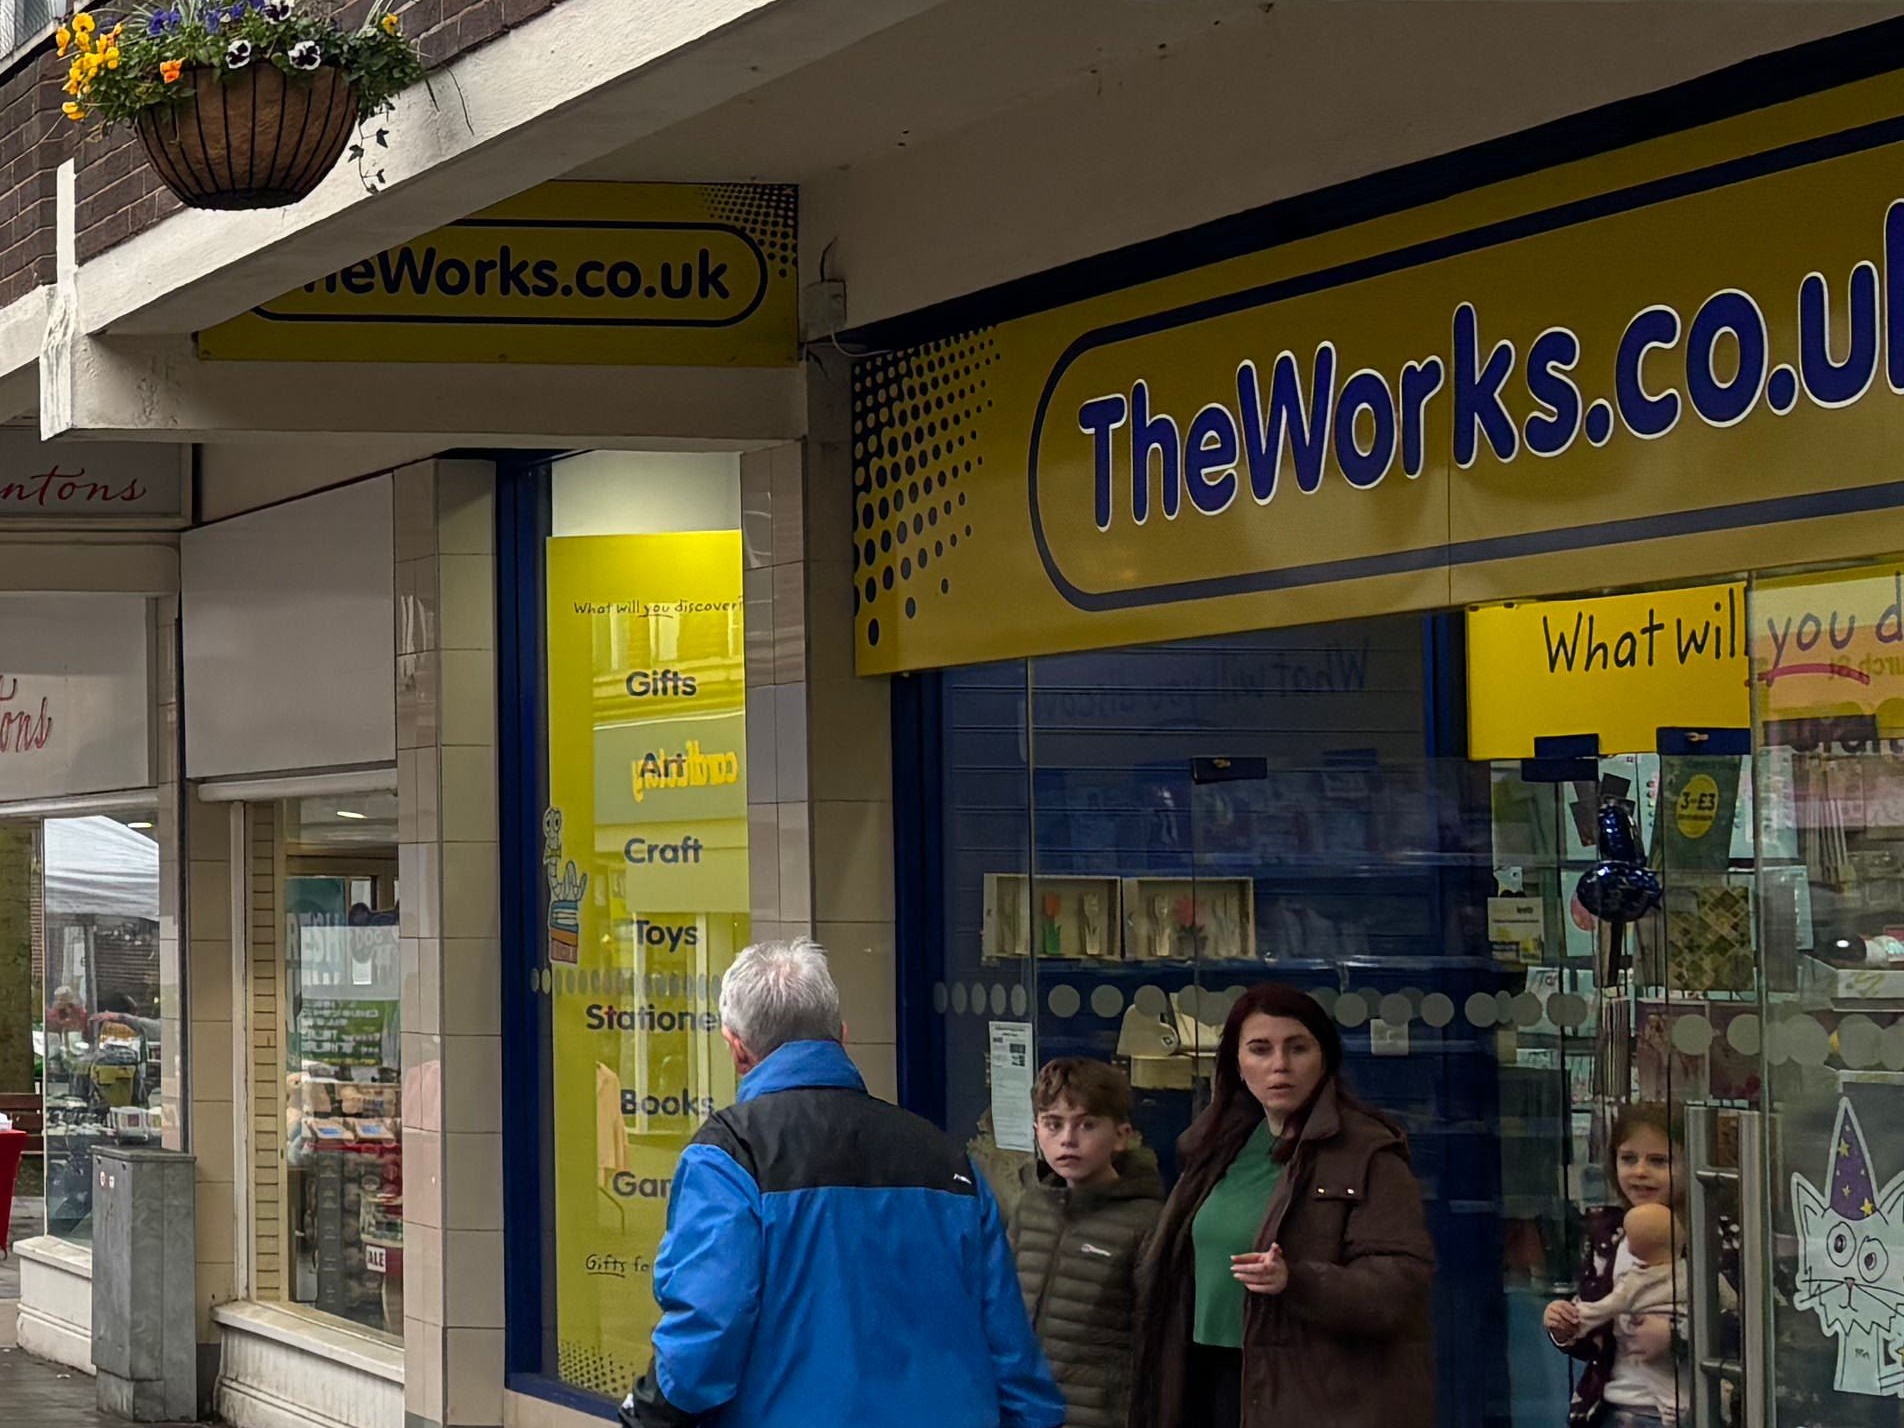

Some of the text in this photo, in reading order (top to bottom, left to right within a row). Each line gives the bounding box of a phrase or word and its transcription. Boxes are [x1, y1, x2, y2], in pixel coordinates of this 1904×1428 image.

[304, 246, 729, 299] eWorks.co.uk
[573, 602, 611, 614] What
[617, 600, 640, 614] will
[643, 605, 670, 617] you
[1543, 614, 1664, 673] What
[1767, 611, 1856, 687] you
[626, 669, 696, 696] Gifts
[640, 753, 686, 777] Art
[624, 836, 703, 864] Craft
[636, 920, 698, 952] Toys
[586, 1004, 720, 1032] Statione
[621, 1089, 714, 1115] Books
[586, 1254, 625, 1273] Gifts
